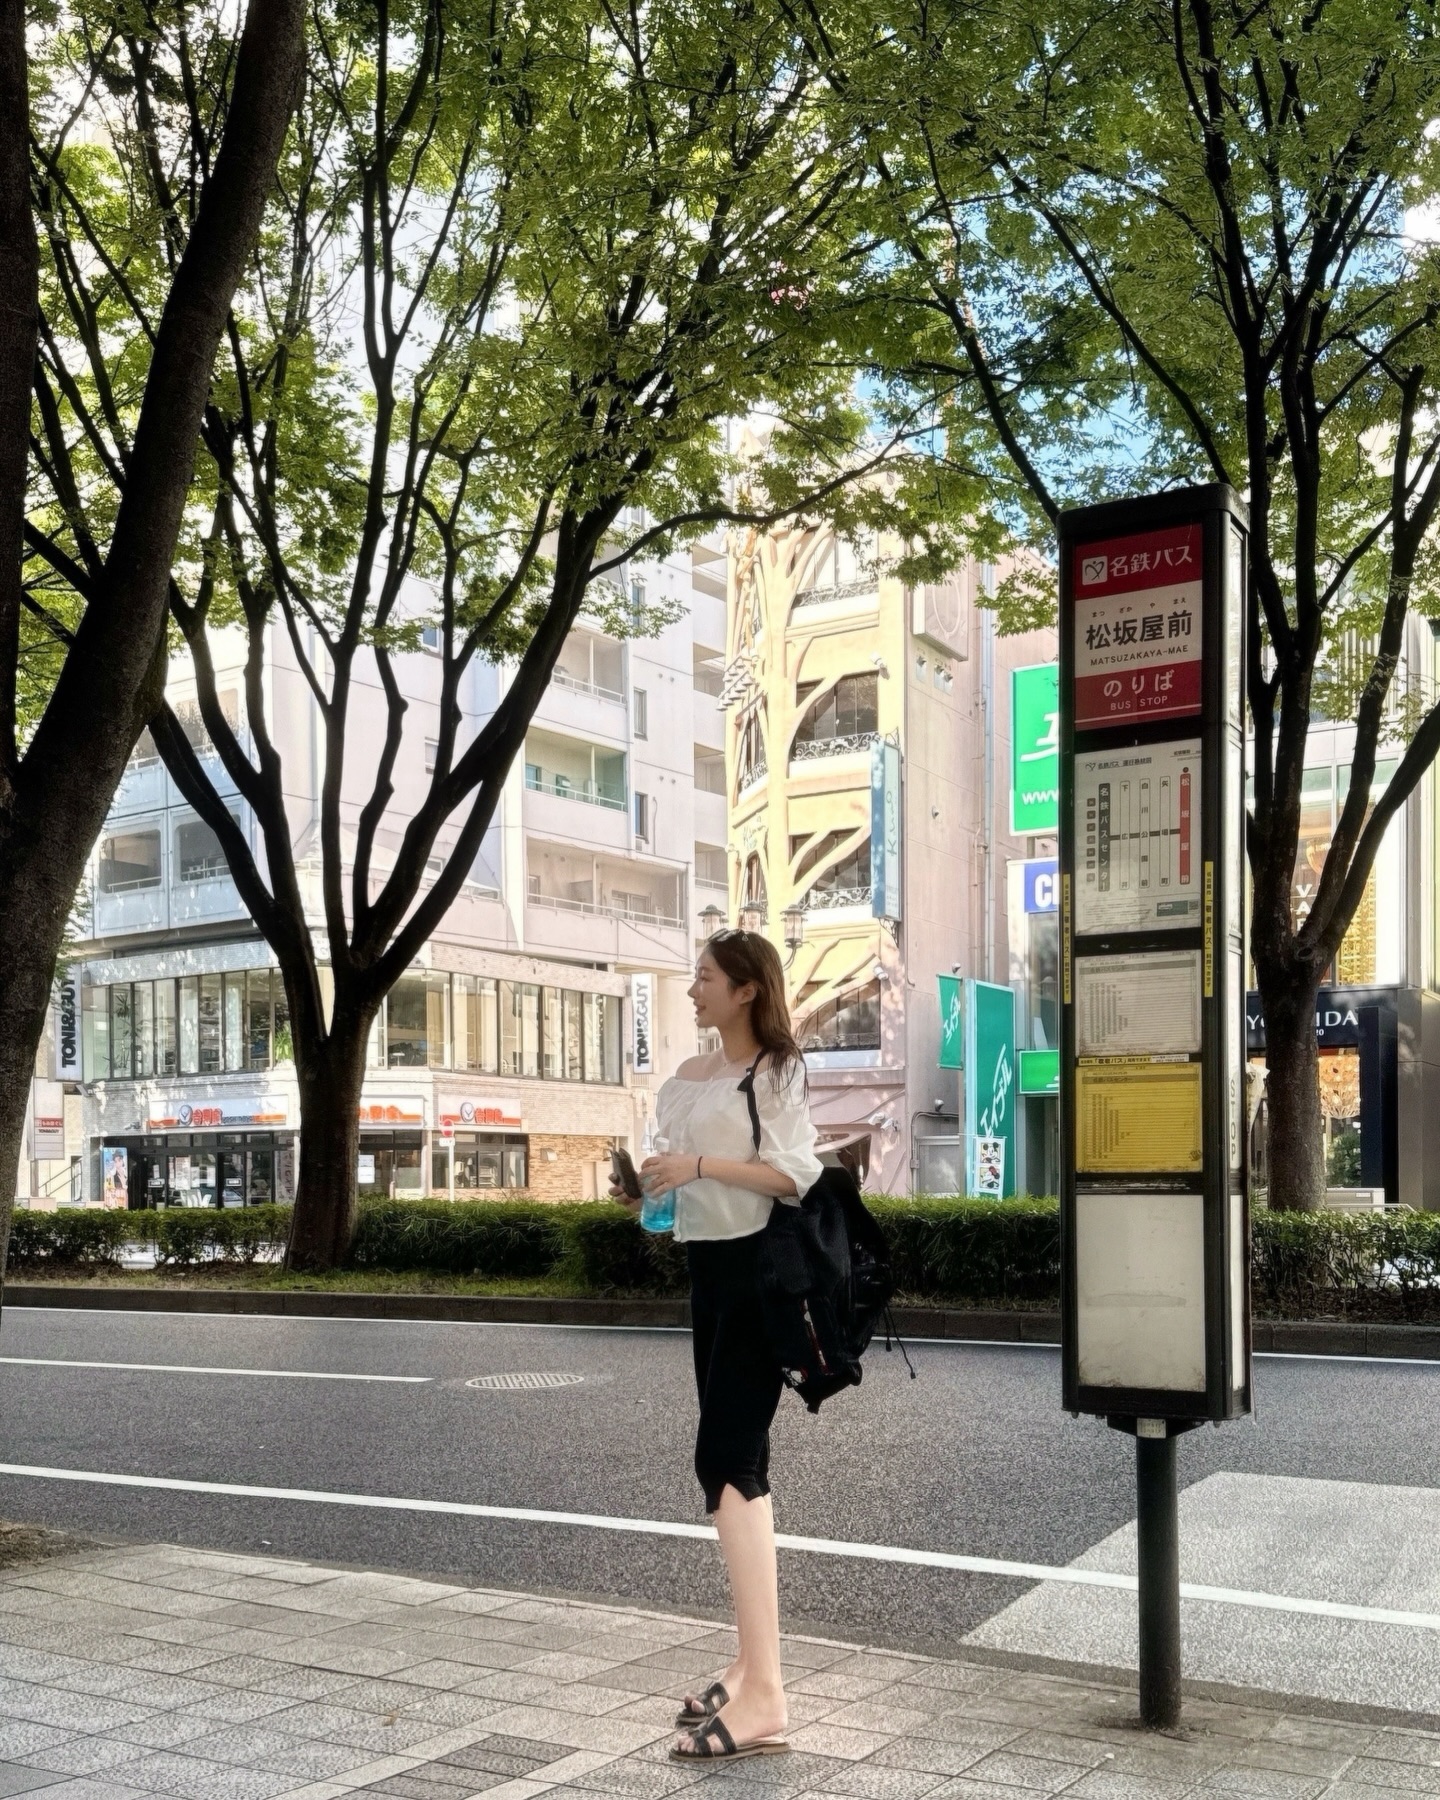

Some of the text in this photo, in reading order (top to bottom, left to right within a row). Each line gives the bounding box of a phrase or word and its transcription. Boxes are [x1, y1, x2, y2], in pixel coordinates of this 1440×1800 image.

[1110, 545, 1193, 577] 名鉄バス
[1173, 597, 1186, 605] まえ
[1085, 609, 1193, 650] 松坂屋前
[1090, 645, 1188, 666] MATSUZAKAYA-MAE
[1103, 669, 1175, 698] のりば
[1110, 696, 1168, 711] BUS STOP
[1100, 787, 1109, 890] 名鉄バスセンター
[636, 982, 649, 1067] TONI&GUY
[1247, 1010, 1358, 1030] YIDA
